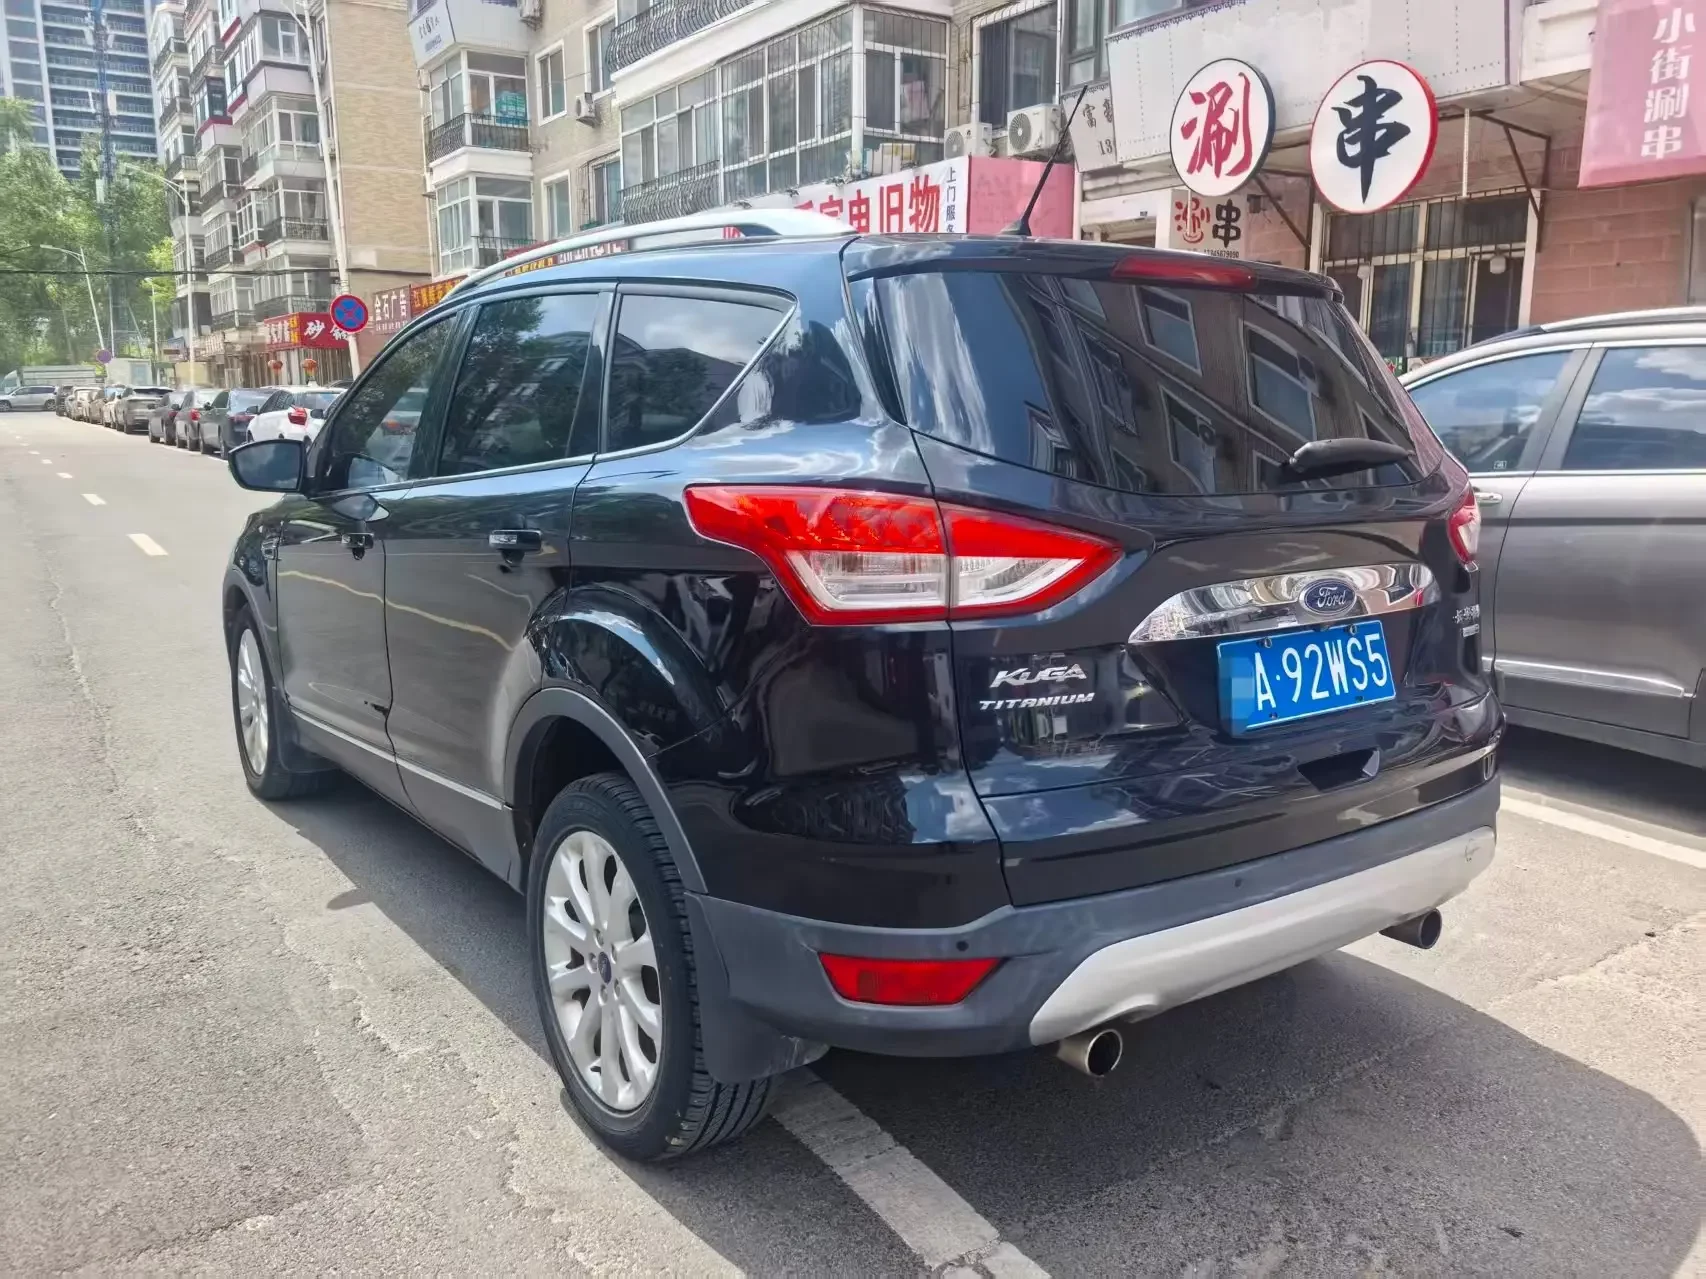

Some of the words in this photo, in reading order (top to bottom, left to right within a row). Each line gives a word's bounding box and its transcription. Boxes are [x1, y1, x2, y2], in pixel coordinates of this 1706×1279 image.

[1640, 8, 1696, 159] 小街涮串
[1181, 71, 1253, 179] 涮
[1331, 74, 1412, 204] 串
[794, 174, 941, 234] 电旧物
[1174, 196, 1242, 249] 涮串
[375, 288, 407, 322] 金石广告
[1317, 586, 1347, 608] Ford
[989, 664, 1087, 689] KUGA
[979, 692, 1096, 710] TITANIUM
